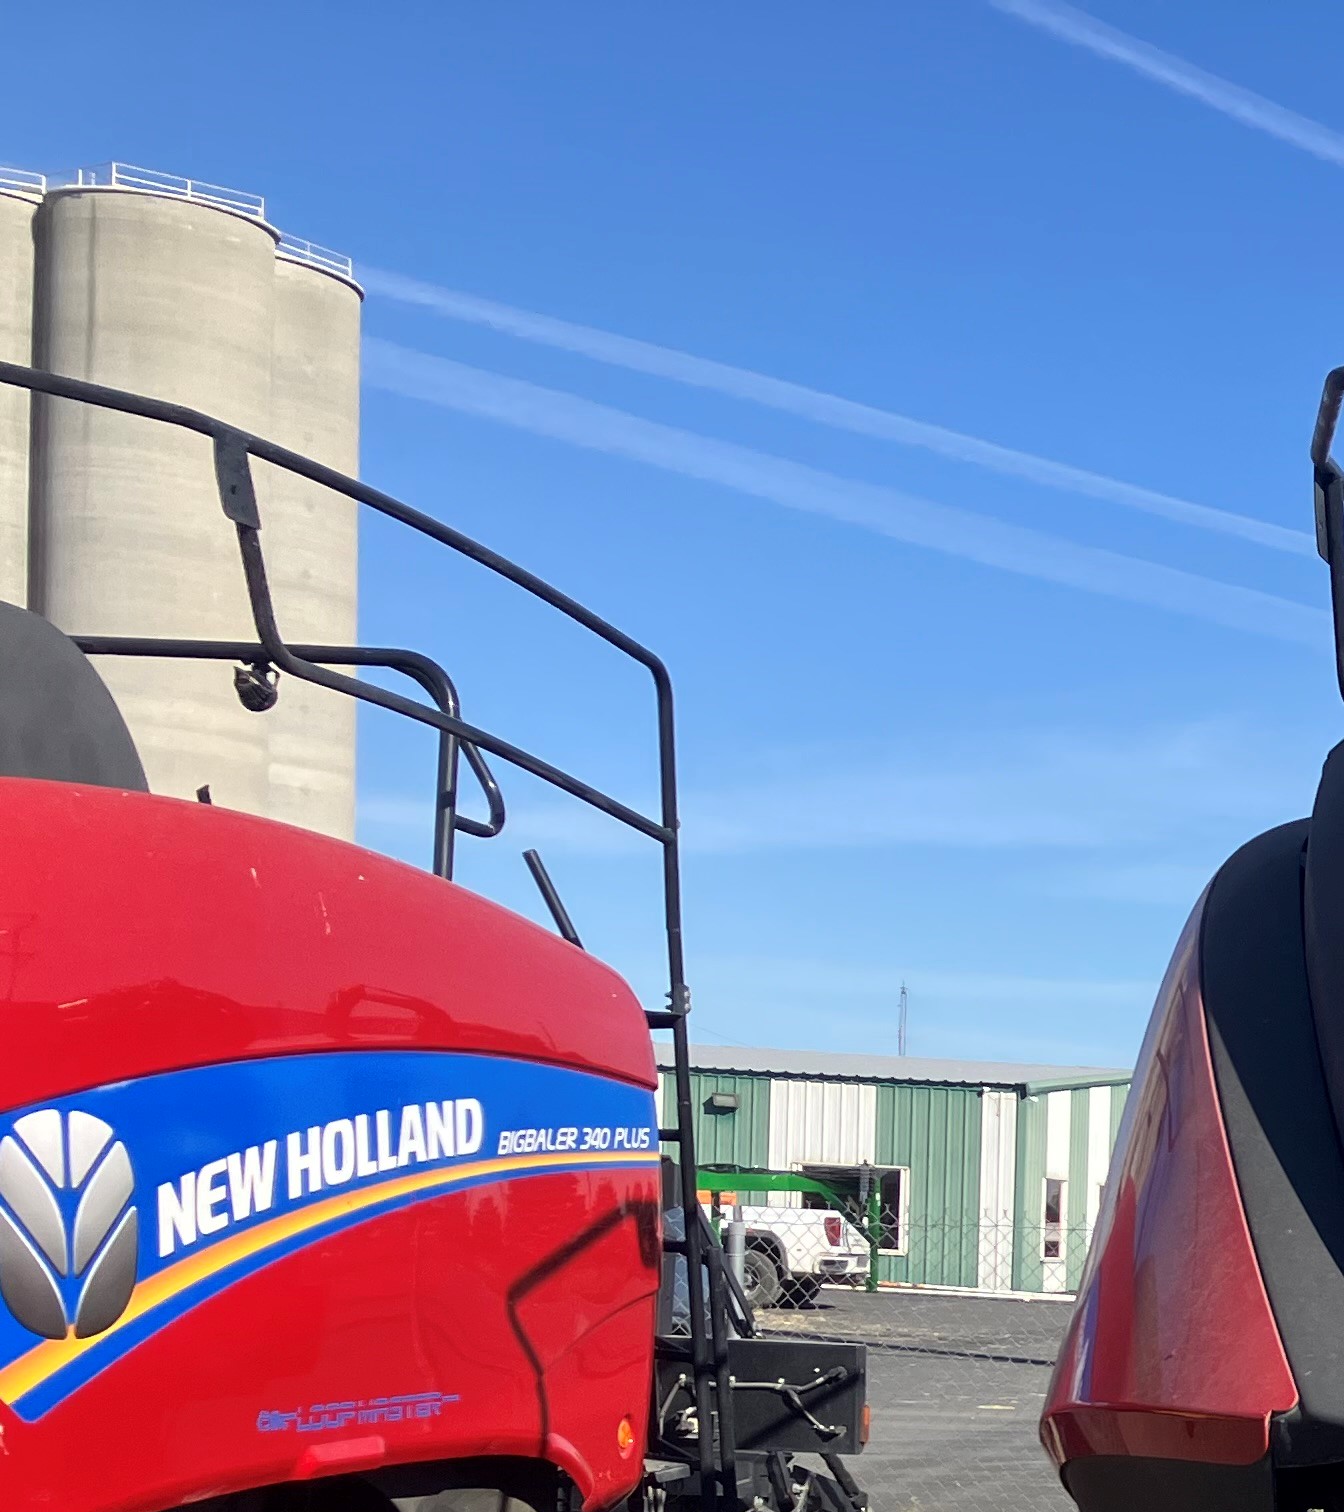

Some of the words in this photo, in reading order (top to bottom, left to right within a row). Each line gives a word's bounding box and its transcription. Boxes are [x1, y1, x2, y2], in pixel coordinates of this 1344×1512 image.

[156, 1138, 278, 1259] NEW
[286, 1097, 485, 1201] HOLLAND
[497, 1126, 579, 1155] BIGBALER
[580, 1127, 611, 1150] 340
[613, 1127, 650, 1149] PLUS
